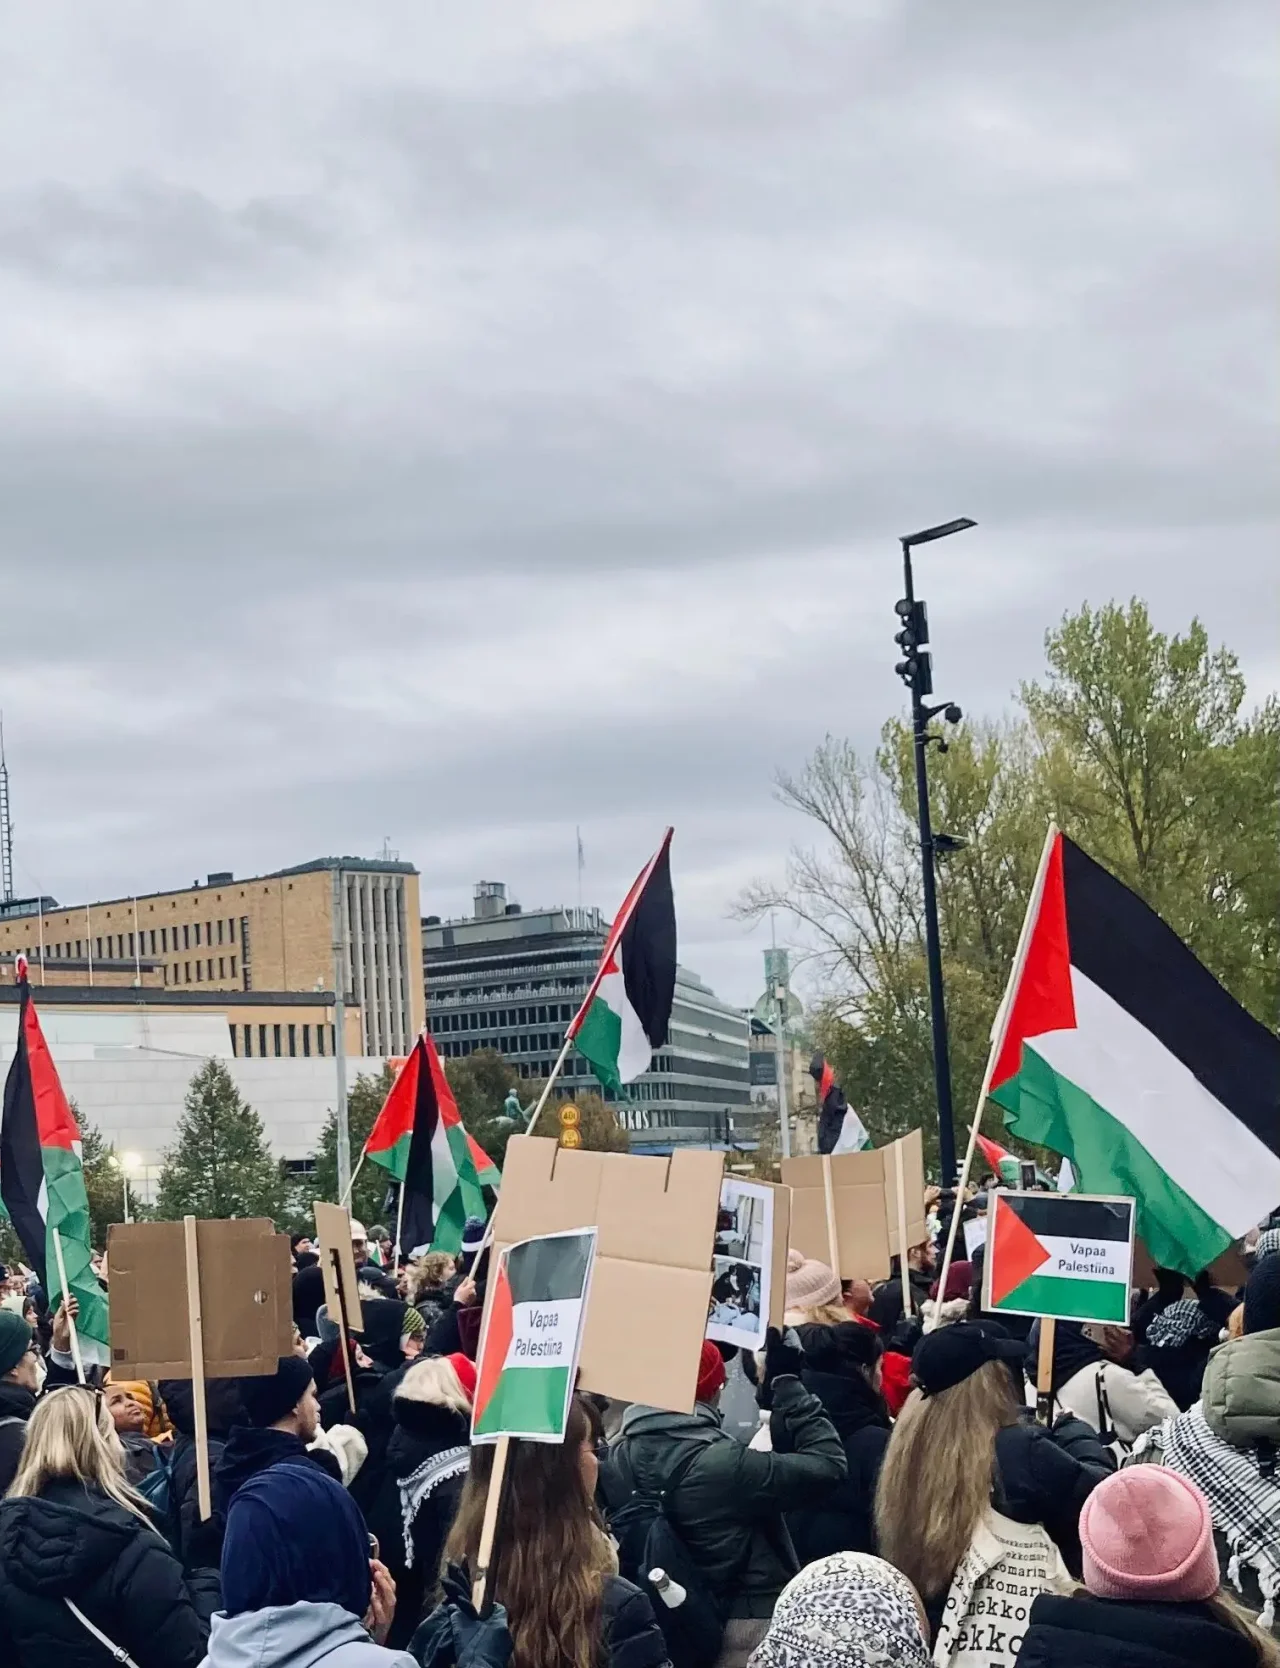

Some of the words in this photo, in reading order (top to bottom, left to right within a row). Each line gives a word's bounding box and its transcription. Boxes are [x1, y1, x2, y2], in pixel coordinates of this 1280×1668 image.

[1070, 1242, 1106, 1257] Vapaa
[1058, 1259, 1115, 1275] Palestiina
[529, 1309, 559, 1332] Vapaa
[514, 1337, 563, 1357] Palestiina
